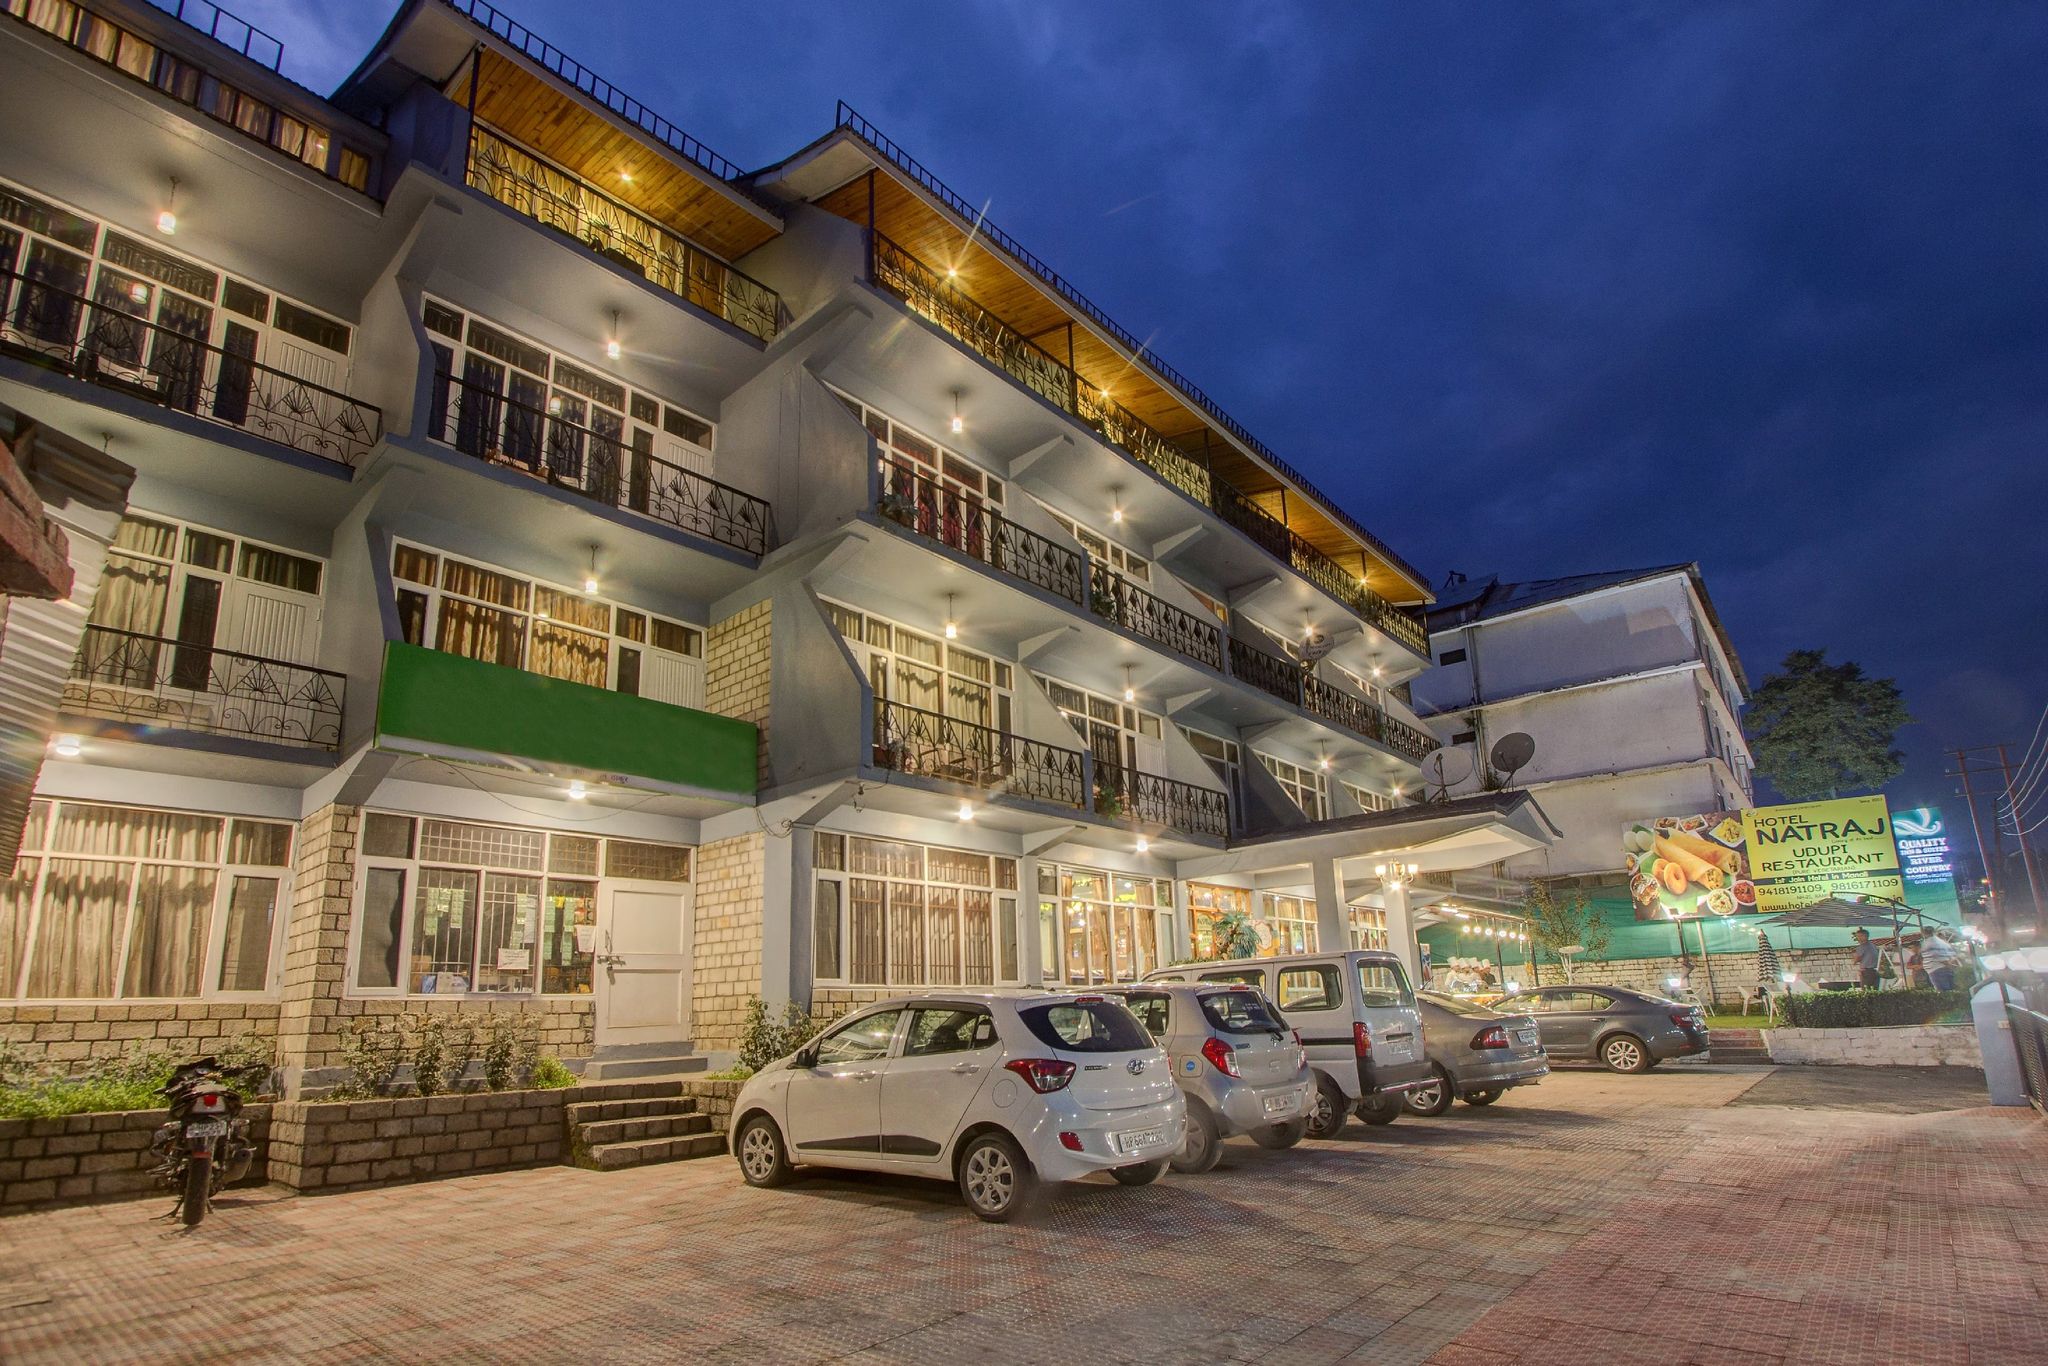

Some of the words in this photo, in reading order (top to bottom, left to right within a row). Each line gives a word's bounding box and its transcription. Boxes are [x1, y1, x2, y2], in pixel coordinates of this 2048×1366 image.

[1754, 815, 1808, 827] HOTEL
[1756, 818, 1885, 845] NATRAJ
[1898, 837, 1947, 850] QUALITY
[1793, 844, 1848, 858] UDUPI
[1762, 853, 1884, 872] RESTAURANT
[1910, 856, 1943, 865] RIVER
[1905, 864, 1952, 874] COUNTRY
[1808, 873, 1829, 881] Hotel
[1758, 884, 1826, 896] 9418191109,
[1831, 878, 1899, 891] 9816171109
